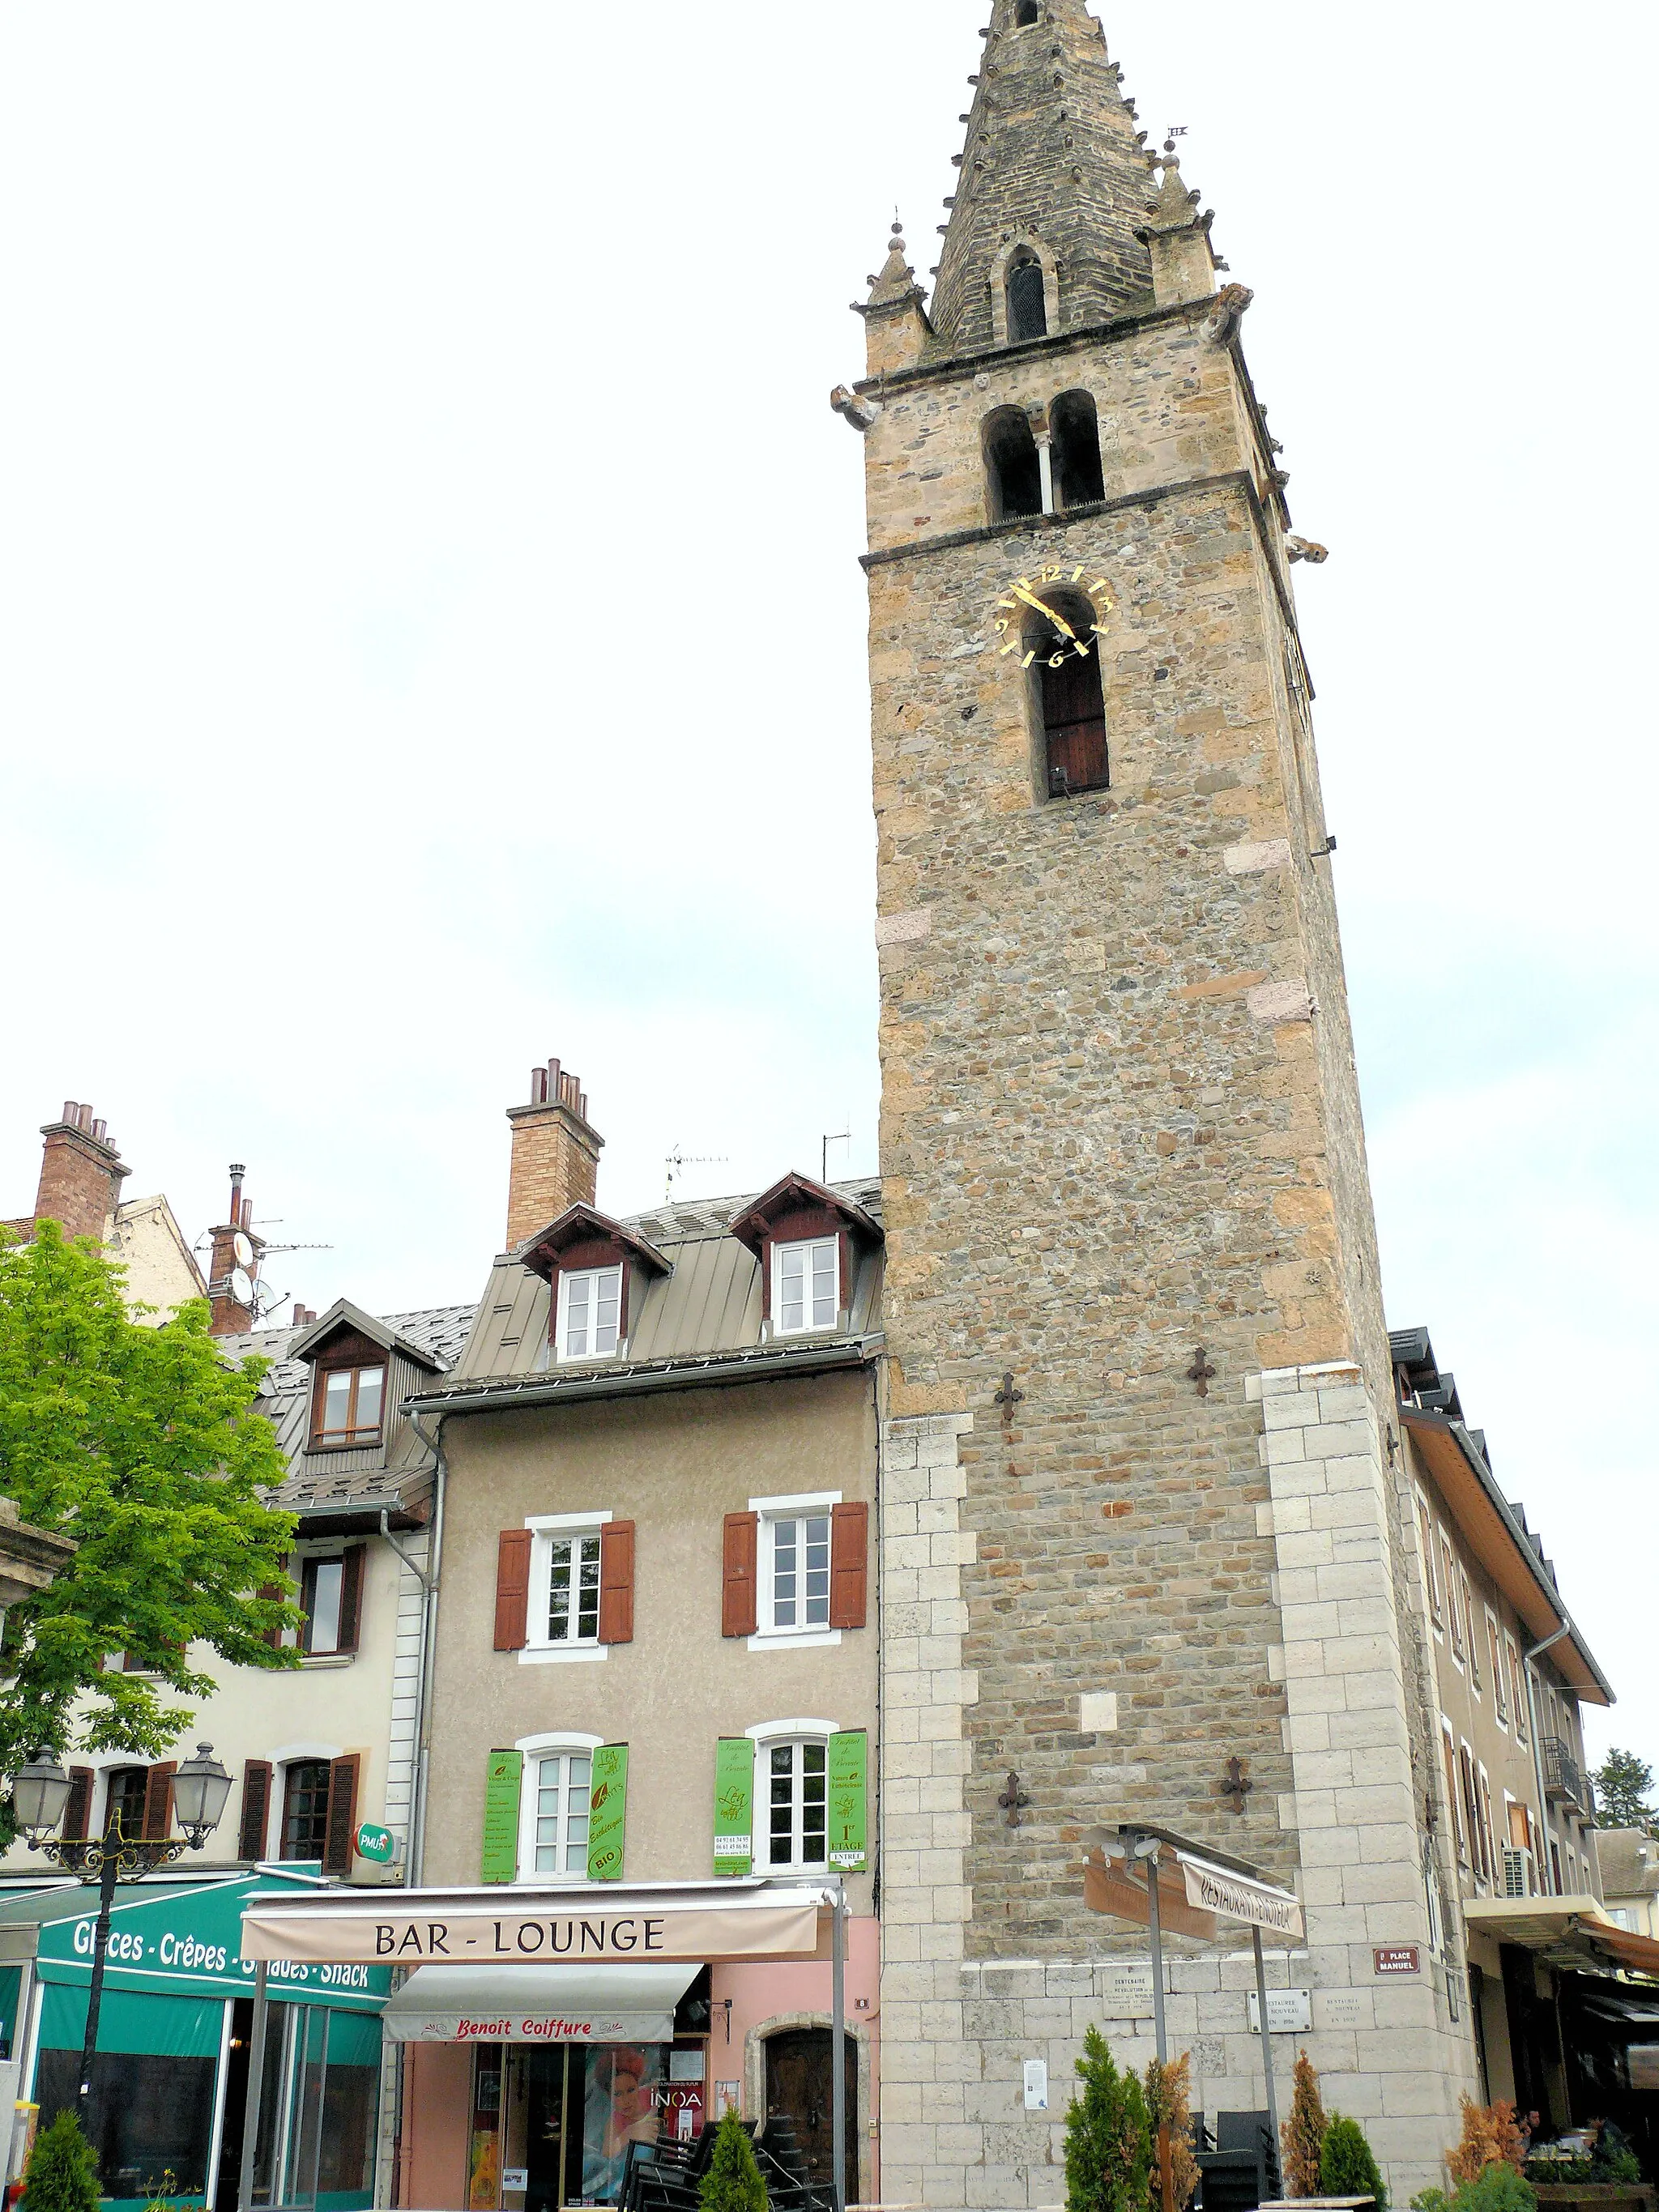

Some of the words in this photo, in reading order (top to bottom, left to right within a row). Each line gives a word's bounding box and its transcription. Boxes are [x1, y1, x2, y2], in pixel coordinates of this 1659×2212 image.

[1039, 565, 1062, 583] 12
[1098, 596, 1114, 613] 3
[994, 619, 1009, 637] 9
[1048, 650, 1064, 668] 6
[360, 1834, 380, 1849] PMU
[595, 1852, 615, 1869] BIO
[74, 1920, 144, 1961] Glces
[160, 1933, 227, 1971] Crêpes
[375, 1923, 451, 1956] BAR
[493, 1918, 665, 1954] LOUNGE
[1389, 1952, 1411, 1960] PLACE
[1380, 1962, 1414, 1970] MANUEL
[454, 2018, 512, 2041] Benoît
[522, 2018, 591, 2039] Coiffure
